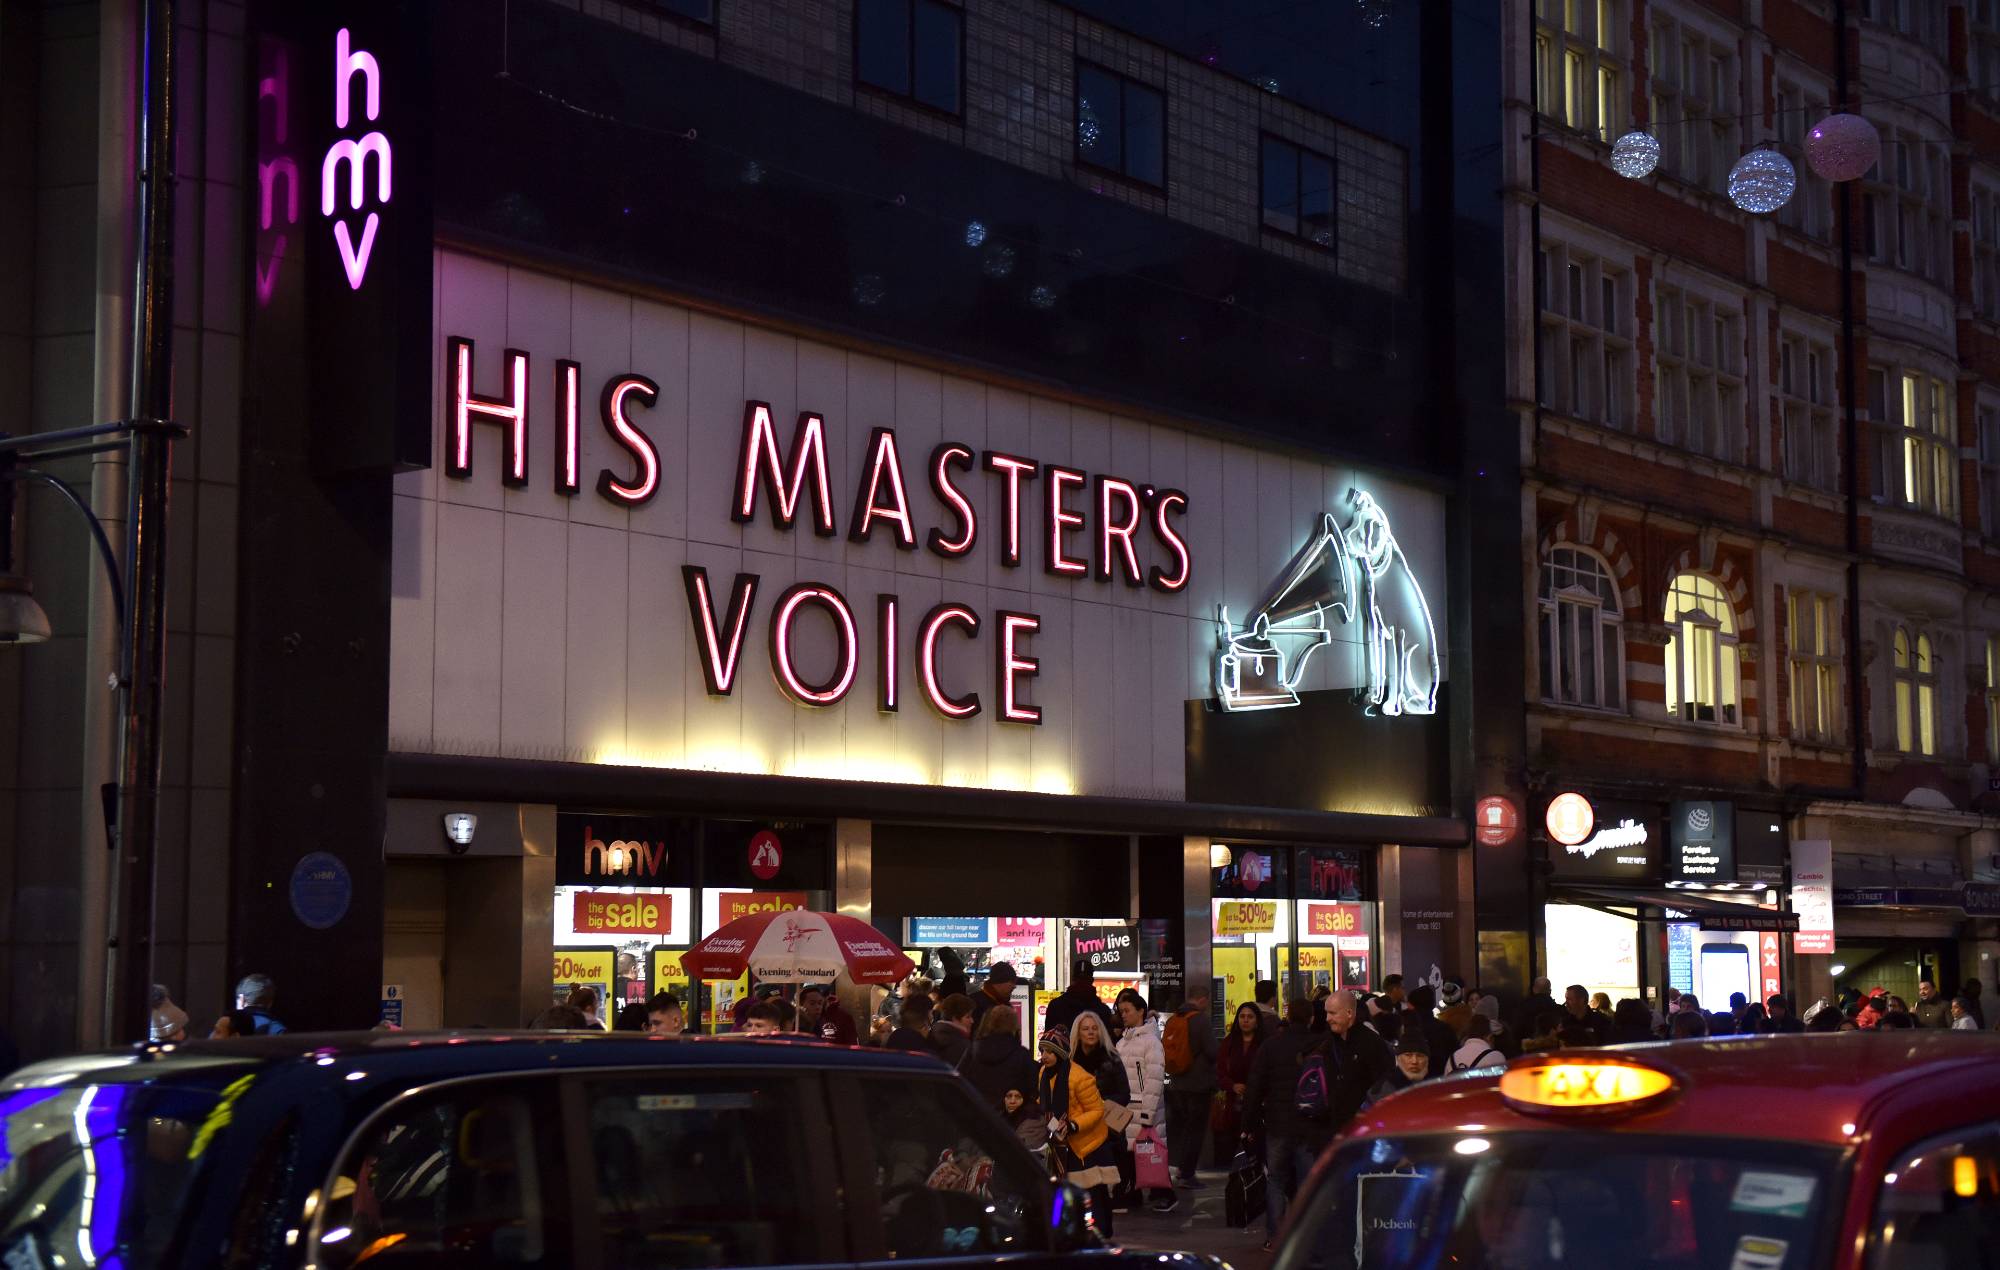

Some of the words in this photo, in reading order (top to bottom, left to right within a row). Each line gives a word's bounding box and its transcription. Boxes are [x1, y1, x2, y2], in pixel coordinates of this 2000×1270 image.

[322, 27, 392, 290] hmv
[445, 335, 662, 506] HIS
[731, 399, 1192, 594] MASTER'S
[681, 564, 1042, 726] VOICE
[583, 825, 665, 877] hmv
[1797, 873, 1824, 881] Cambio
[588, 901, 603, 914] the
[605, 896, 659, 928] sale
[732, 901, 746, 913] the
[1239, 903, 1267, 923] 50%
[588, 915, 603, 929] big
[1325, 907, 1354, 931] sale
[1006, 929, 1024, 937] and
[703, 945, 745, 953] Standard
[708, 937, 746, 949] Evening
[1076, 937, 1105, 954] hmv
[1107, 933, 1130, 949] live
[1091, 950, 1120, 967] @363
[1299, 951, 1318, 967] 50%
[587, 966, 602, 978] off
[661, 964, 681, 977] CDs
[758, 967, 792, 978] Evening
[797, 966, 836, 977] Standard
[1226, 973, 1235, 985] to
[1529, 1068, 1621, 1101] TAXI
